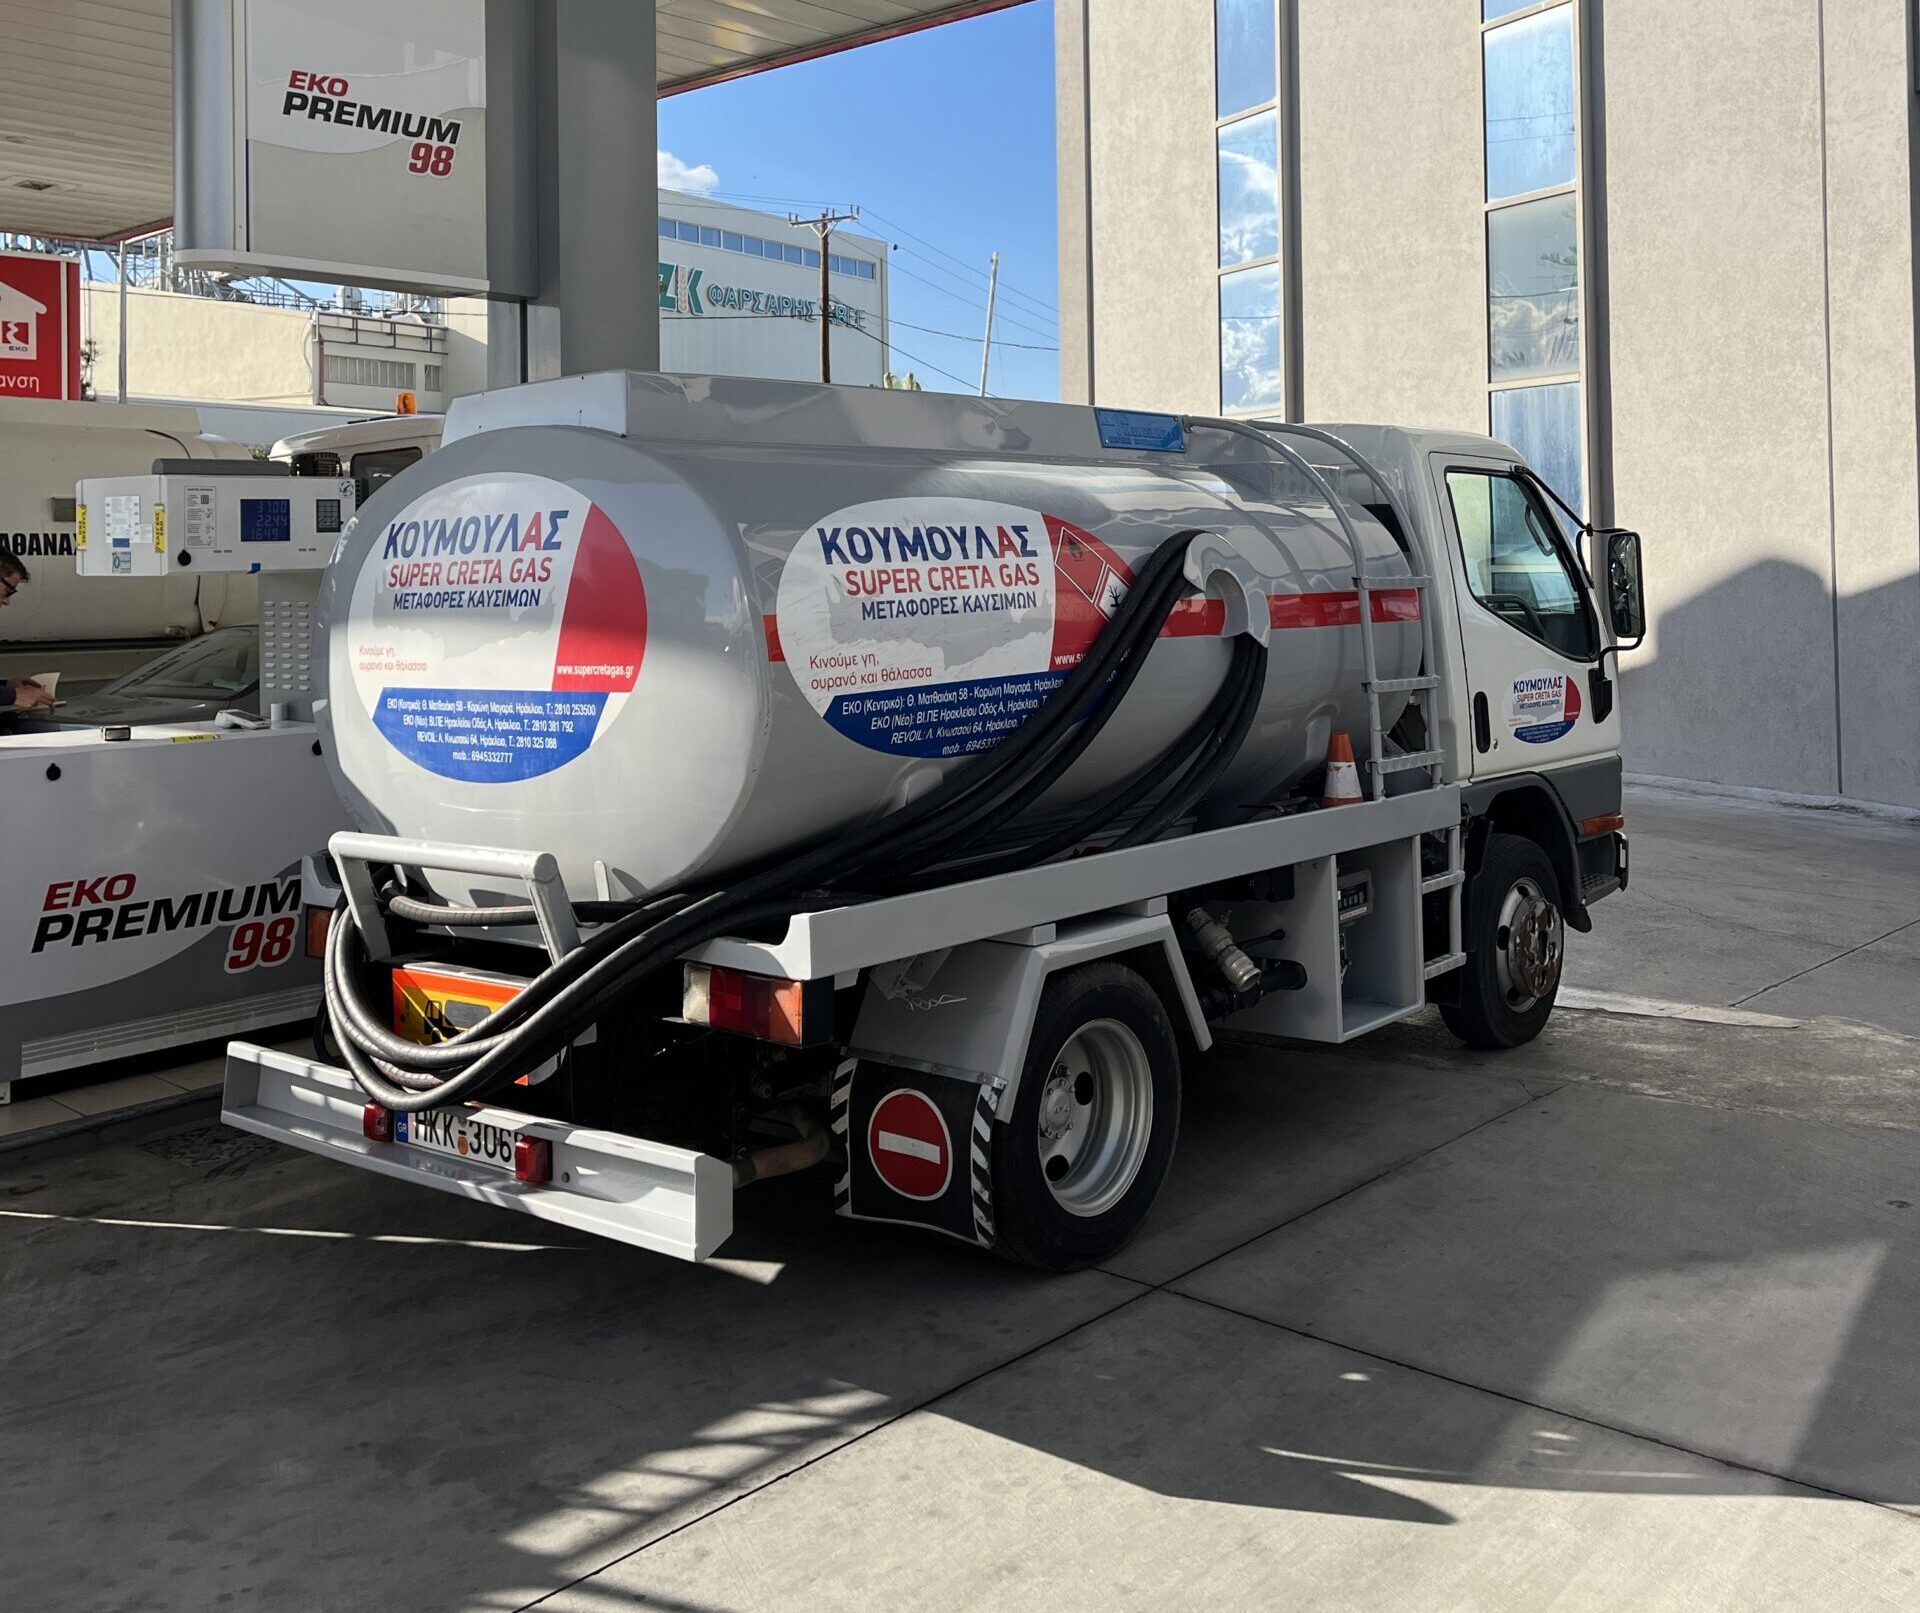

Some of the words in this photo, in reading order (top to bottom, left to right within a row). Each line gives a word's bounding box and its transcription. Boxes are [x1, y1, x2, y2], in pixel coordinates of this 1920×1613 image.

[288, 70, 349, 97] EKO
[282, 91, 461, 144] PREMIUM
[408, 142, 455, 176] 98
[707, 283, 818, 323] ΦΑΡΣΑΡΗΣ
[382, 510, 569, 560] ΚΟΥΜΟΥΛΑΣ
[817, 525, 1038, 565] ΚΟΥΜΟΥΛΑΣ
[388, 562, 443, 589] SUPER
[446, 559, 503, 586] CRETA
[509, 557, 553, 583] GAS
[845, 568, 922, 597] SUPER
[927, 565, 995, 592] CRETA
[999, 562, 1040, 588] GAS
[393, 591, 465, 610] ΜΕΤΑΦΟΡΕΣ
[467, 588, 541, 608] ΚΑΥΣΙΜΩΝ
[862, 596, 959, 621] ΜΕΤΑΦΟΡΕΣ
[962, 591, 1037, 614] ΚΑΥΣΙΜΩΝ
[557, 663, 634, 678] www.supercretagas.gr
[809, 652, 858, 670] Κινούμε
[861, 653, 879, 668] γη,
[811, 672, 857, 692] ουρανό
[860, 673, 877, 685] και
[881, 667, 932, 682] θάλασσα
[554, 703, 570, 715] 2810
[571, 704, 596, 716] 253500
[842, 700, 862, 715] EKO
[863, 696, 905, 715] (Κεντρικό):
[958, 688, 968, 700] 58
[974, 686, 1002, 699] Κορώνη
[531, 720, 547, 732] 2810
[561, 721, 574, 733] 792
[871, 716, 890, 730] EKO
[891, 714, 914, 730] (Νέο):
[940, 705, 977, 722] Ηρακλείου
[978, 703, 997, 717] Οδός
[516, 736, 531, 748] 2810
[532, 736, 544, 748] 325
[935, 723, 971, 739] Κνωσσού
[471, 751, 513, 763] 6945332777
[43, 873, 136, 912] EKO
[31, 879, 302, 954] PREMIUM
[228, 917, 296, 970] 98
[397, 1121, 408, 1133] GR
